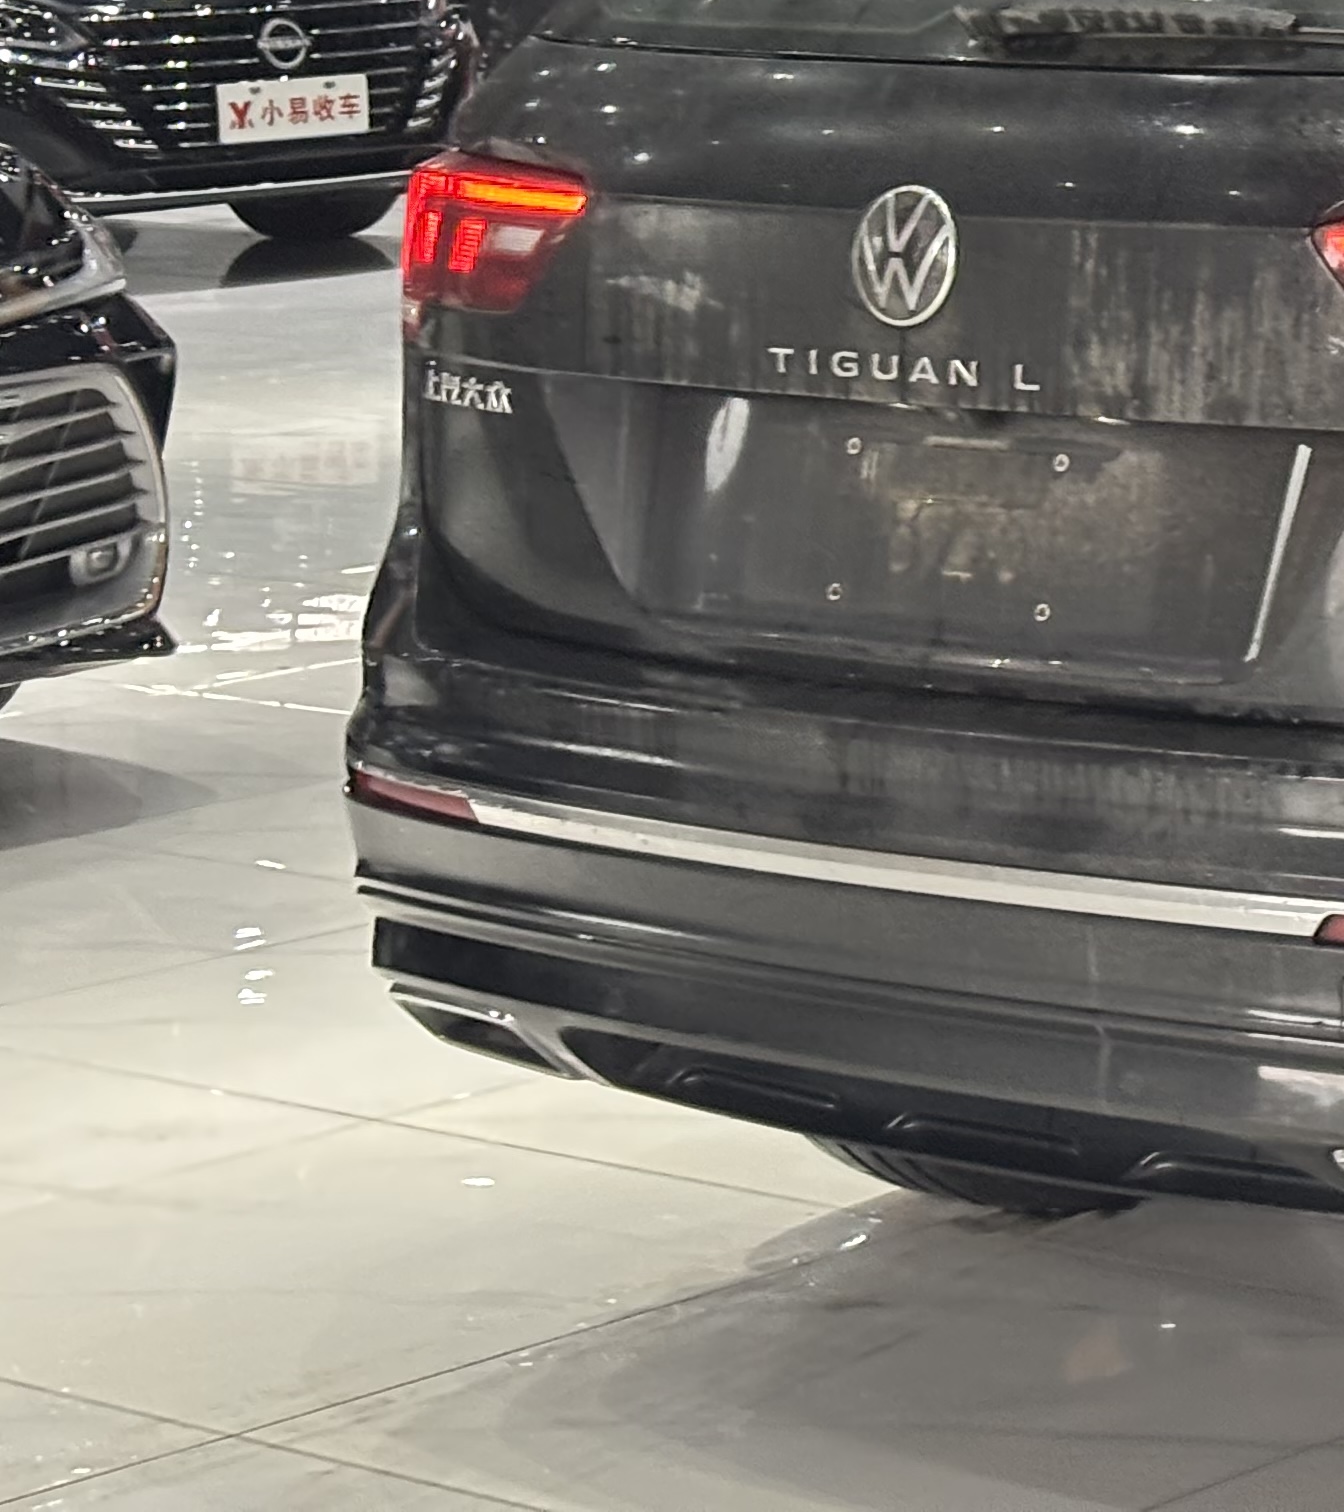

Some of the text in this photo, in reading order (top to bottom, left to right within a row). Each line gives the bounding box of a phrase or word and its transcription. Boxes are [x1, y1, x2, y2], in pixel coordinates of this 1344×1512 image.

[261, 94, 361, 126] 小易收车
[767, 347, 1041, 391] TIGUAN L
